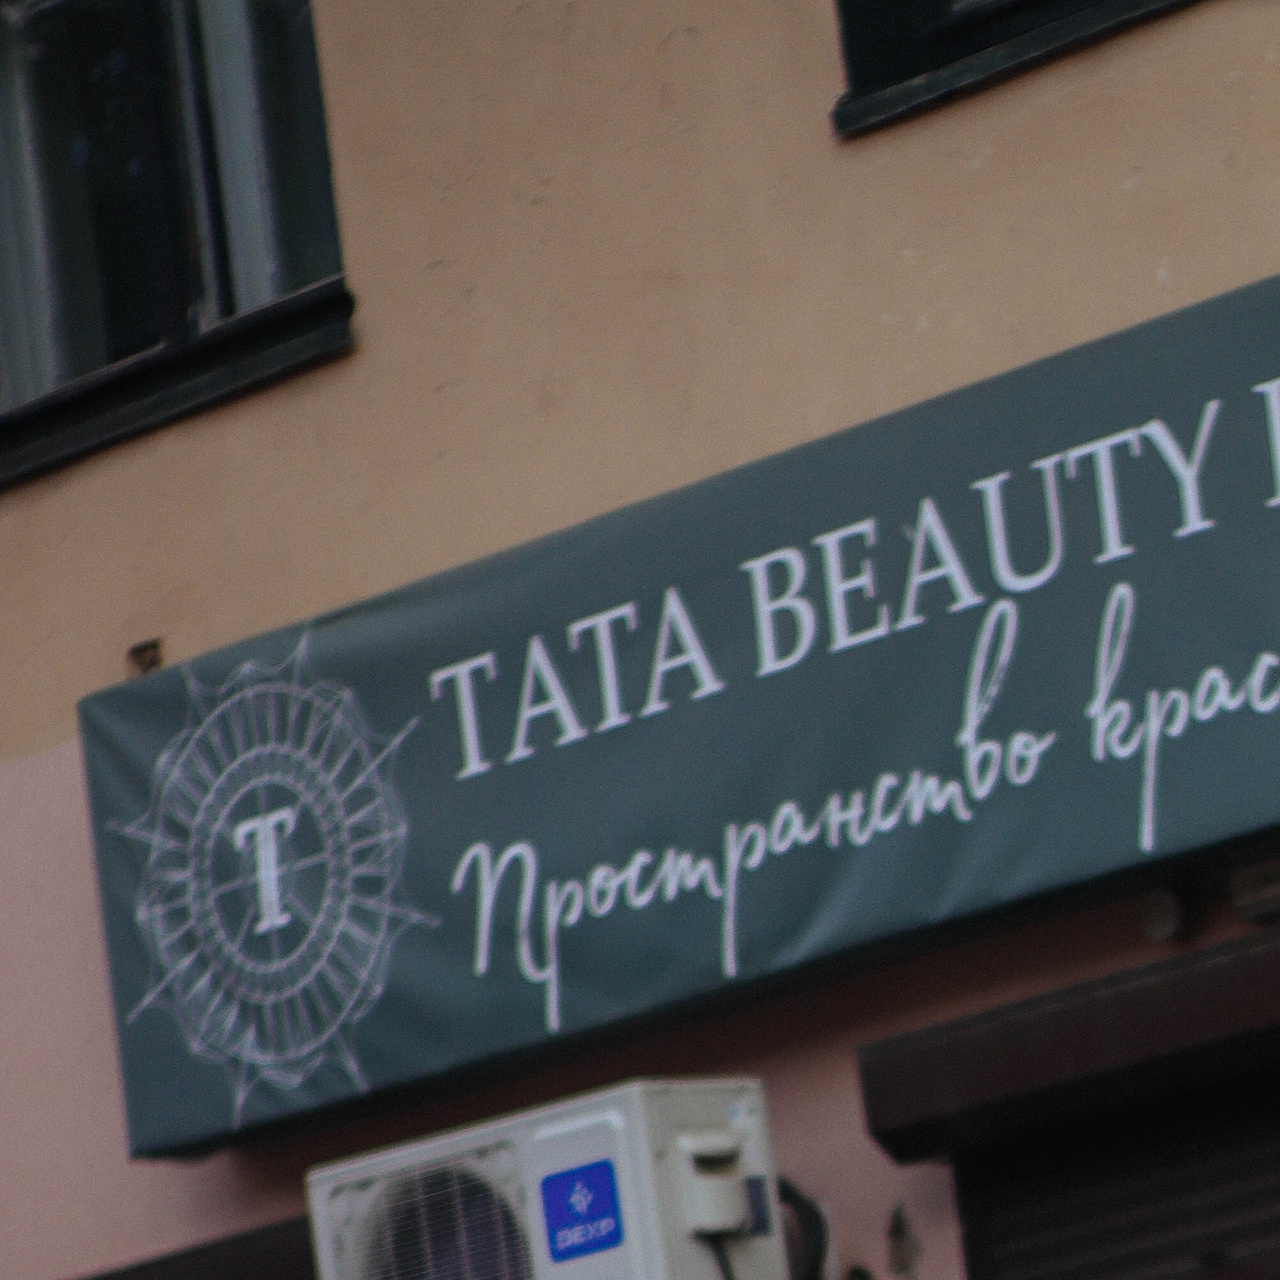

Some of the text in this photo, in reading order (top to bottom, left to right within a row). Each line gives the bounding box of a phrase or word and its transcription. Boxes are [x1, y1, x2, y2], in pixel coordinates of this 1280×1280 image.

[430, 586, 725, 781] TATA
[740, 399, 1222, 680] BEAUTY
[232, 807, 296, 935] T
[452, 598, 1056, 1033] Пространство
